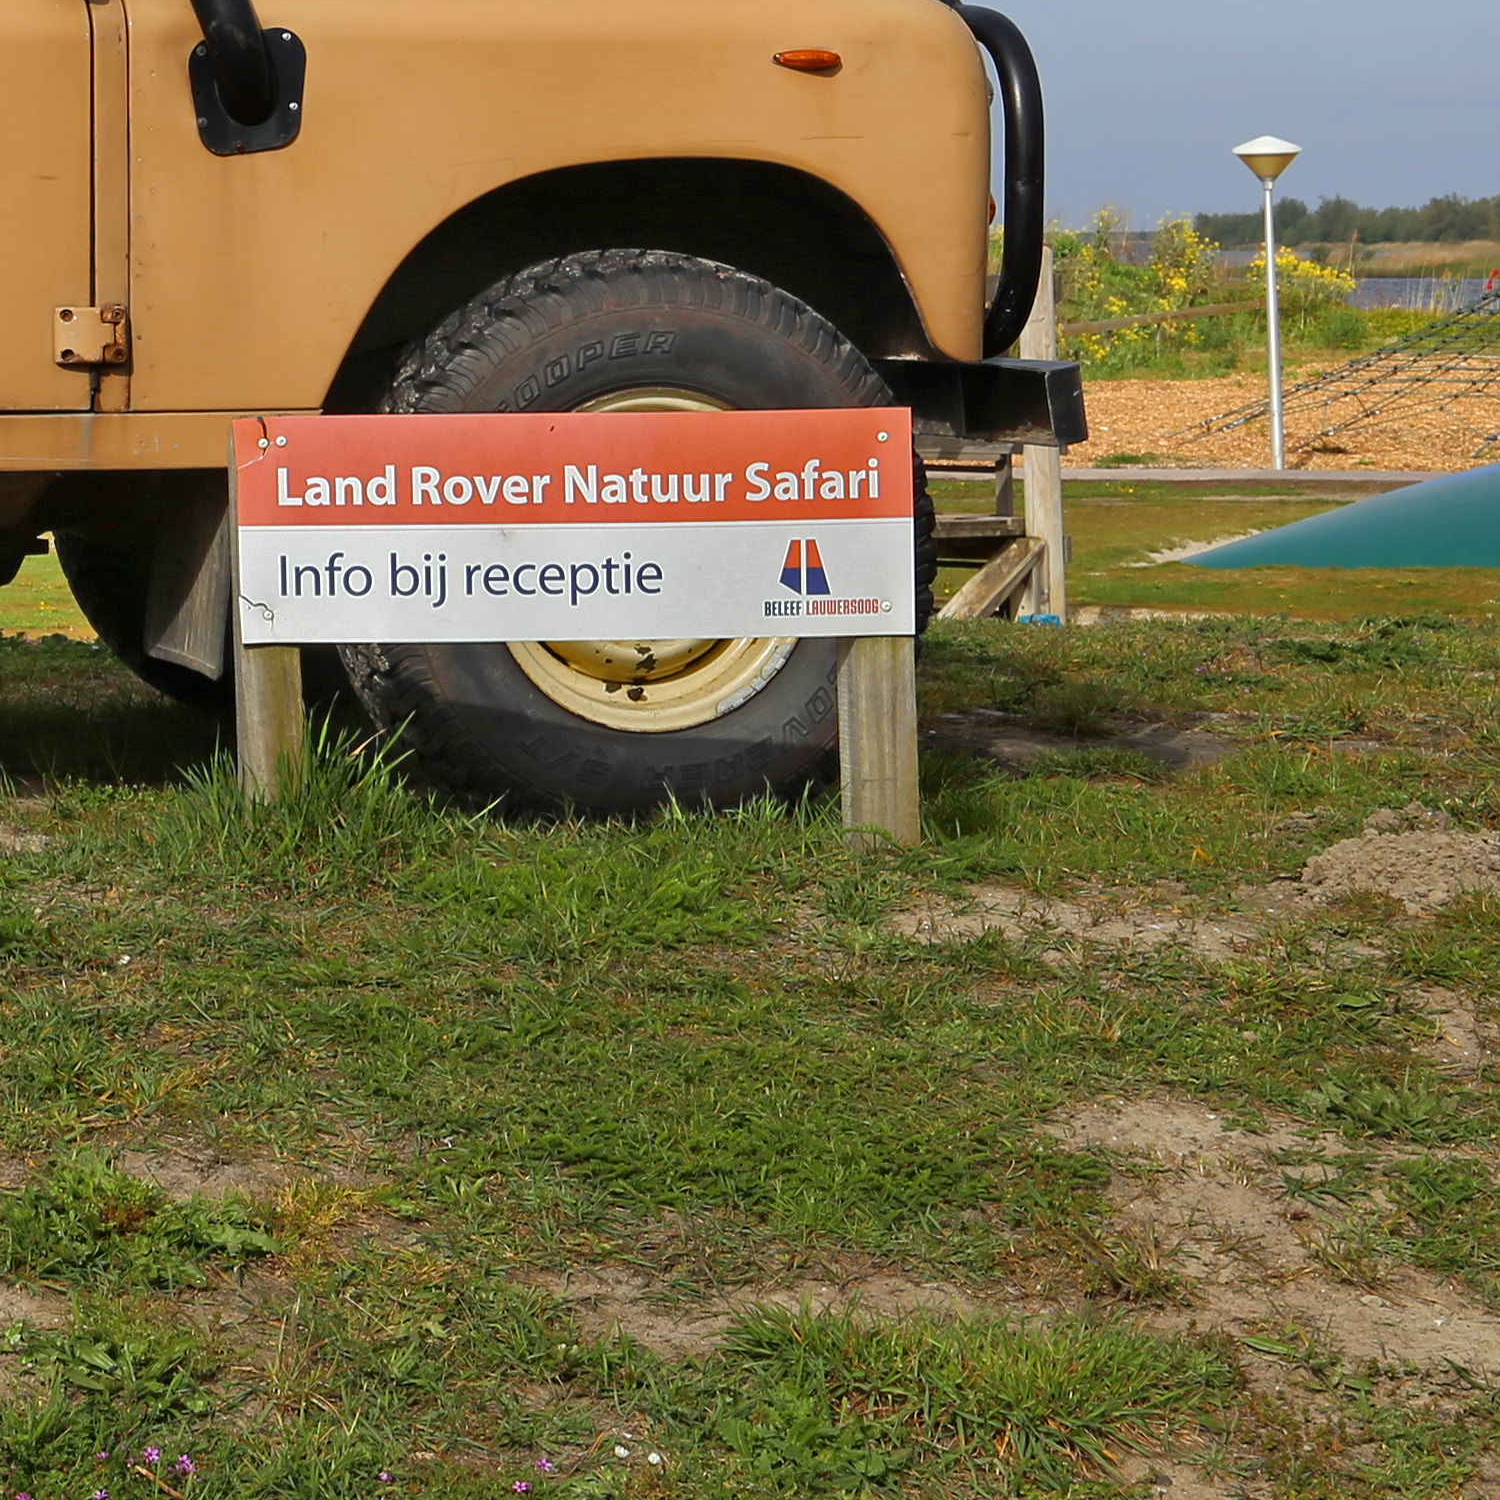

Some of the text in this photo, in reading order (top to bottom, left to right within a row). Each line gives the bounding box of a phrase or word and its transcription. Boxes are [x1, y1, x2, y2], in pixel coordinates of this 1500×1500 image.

[495, 330, 676, 412] OOPER
[277, 457, 879, 506] Land Rover Natuur Safari
[278, 552, 664, 608] Info bij receptie
[764, 599, 879, 617] BELEEF LAUWERSOOG
